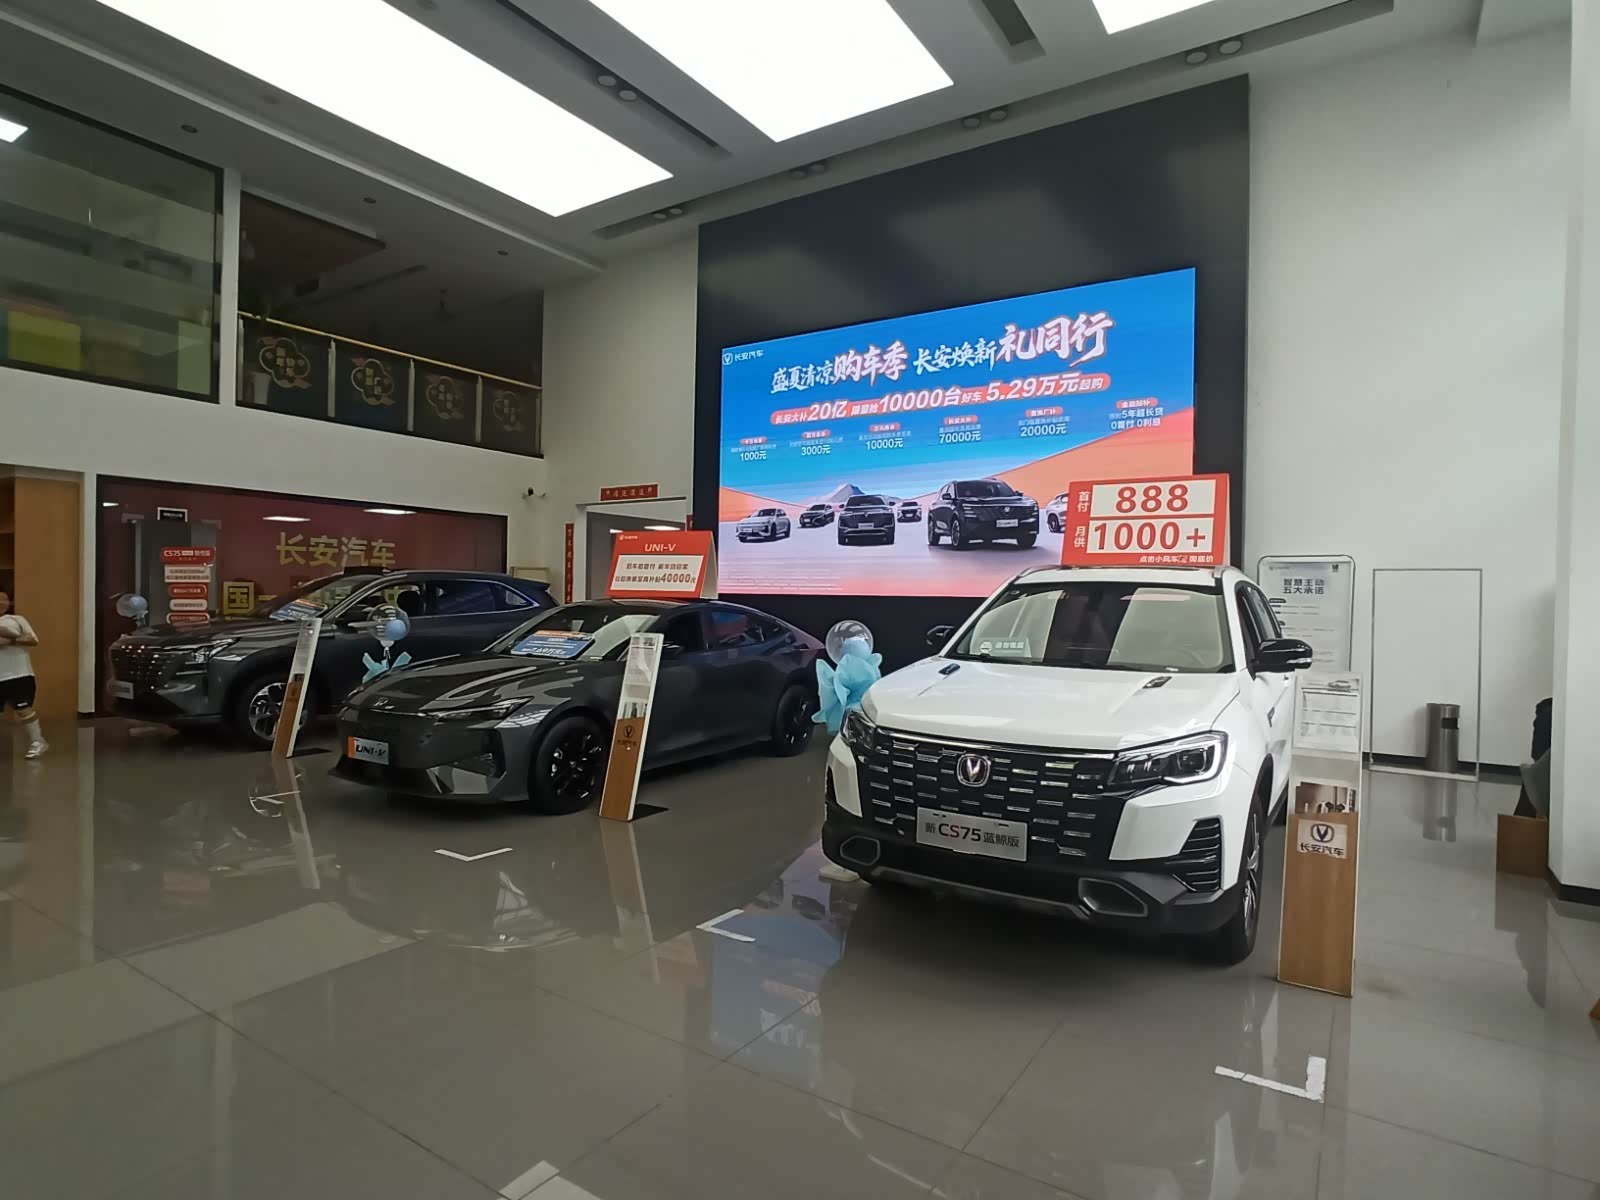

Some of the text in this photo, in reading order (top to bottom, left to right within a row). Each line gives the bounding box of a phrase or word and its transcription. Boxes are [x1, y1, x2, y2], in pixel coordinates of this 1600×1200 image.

[734, 350, 764, 362] 长安汽车
[770, 311, 1114, 395] 盛夏清凉购车季 长安焕新礼同行
[986, 371, 1104, 402] 5.29万元起购
[939, 430, 982, 445] 70000元
[1020, 423, 1067, 437] 20000元
[801, 444, 831, 456] 3000元
[865, 437, 904, 450] 10000元
[740, 452, 767, 462] 1000元
[1078, 491, 1090, 513] 首付
[1115, 484, 1188, 514] 888
[1074, 526, 1086, 548] 月供
[1094, 521, 1206, 550] 1000+
[276, 531, 397, 568] 长安汽车
[644, 543, 676, 552] UNI-V
[938, 823, 982, 842] CS75
[1300, 842, 1344, 856] 长安汽车
